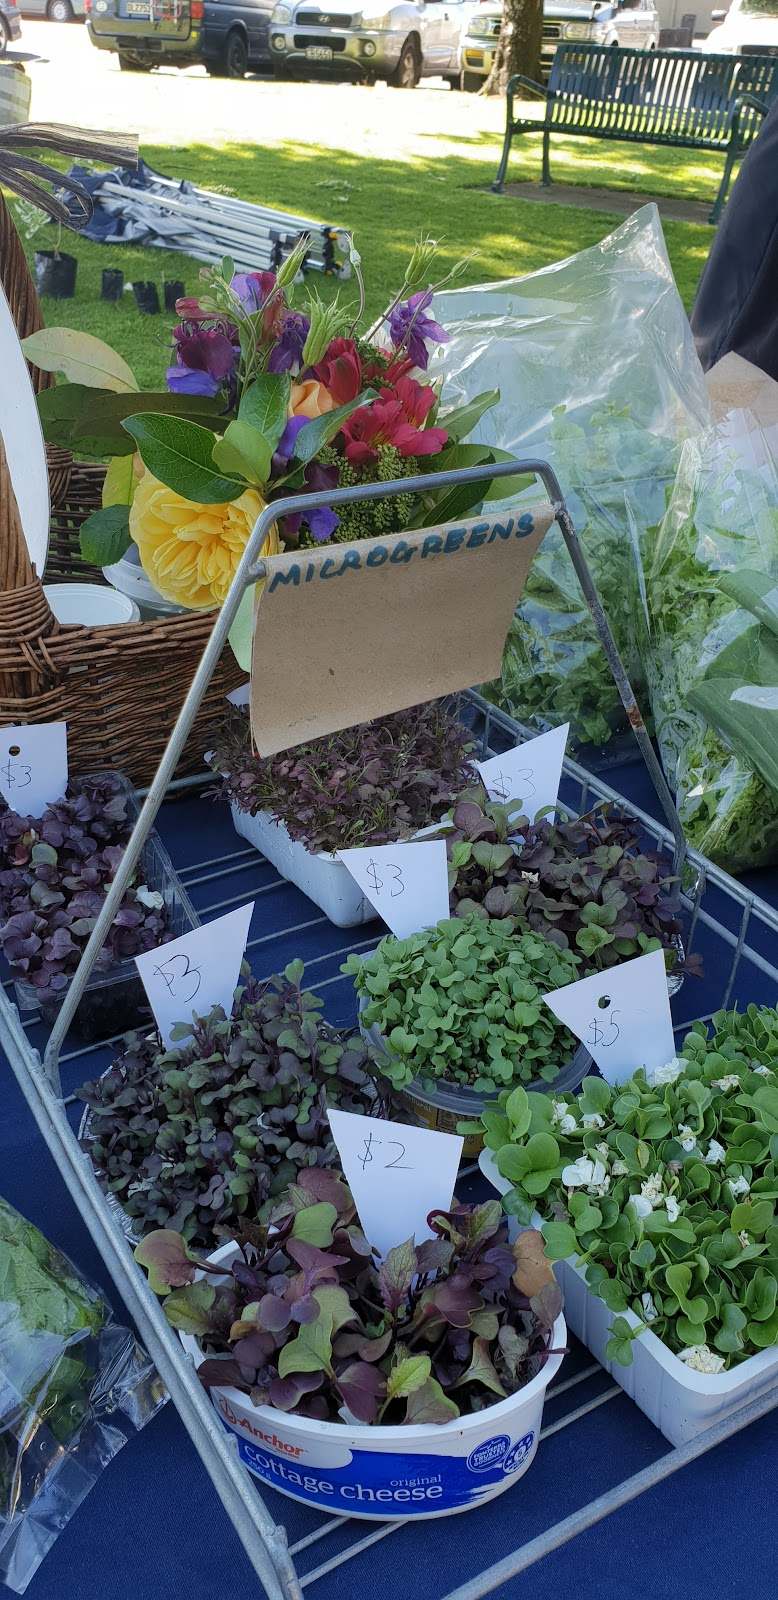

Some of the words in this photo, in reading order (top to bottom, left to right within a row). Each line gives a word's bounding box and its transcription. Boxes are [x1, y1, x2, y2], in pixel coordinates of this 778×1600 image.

[268, 513, 535, 593] MICROGREENS
[0, 758, 32, 789] $3
[489, 768, 537, 803] $3
[366, 858, 405, 898] $3
[153, 954, 202, 1004] $3
[586, 1009, 621, 1047] $5
[357, 1132, 416, 1171] $2
[239, 1418, 304, 1456] Anchor
[244, 1445, 334, 1494] cottage
[340, 1484, 443, 1502] cheese
[390, 1474, 442, 1488] original
